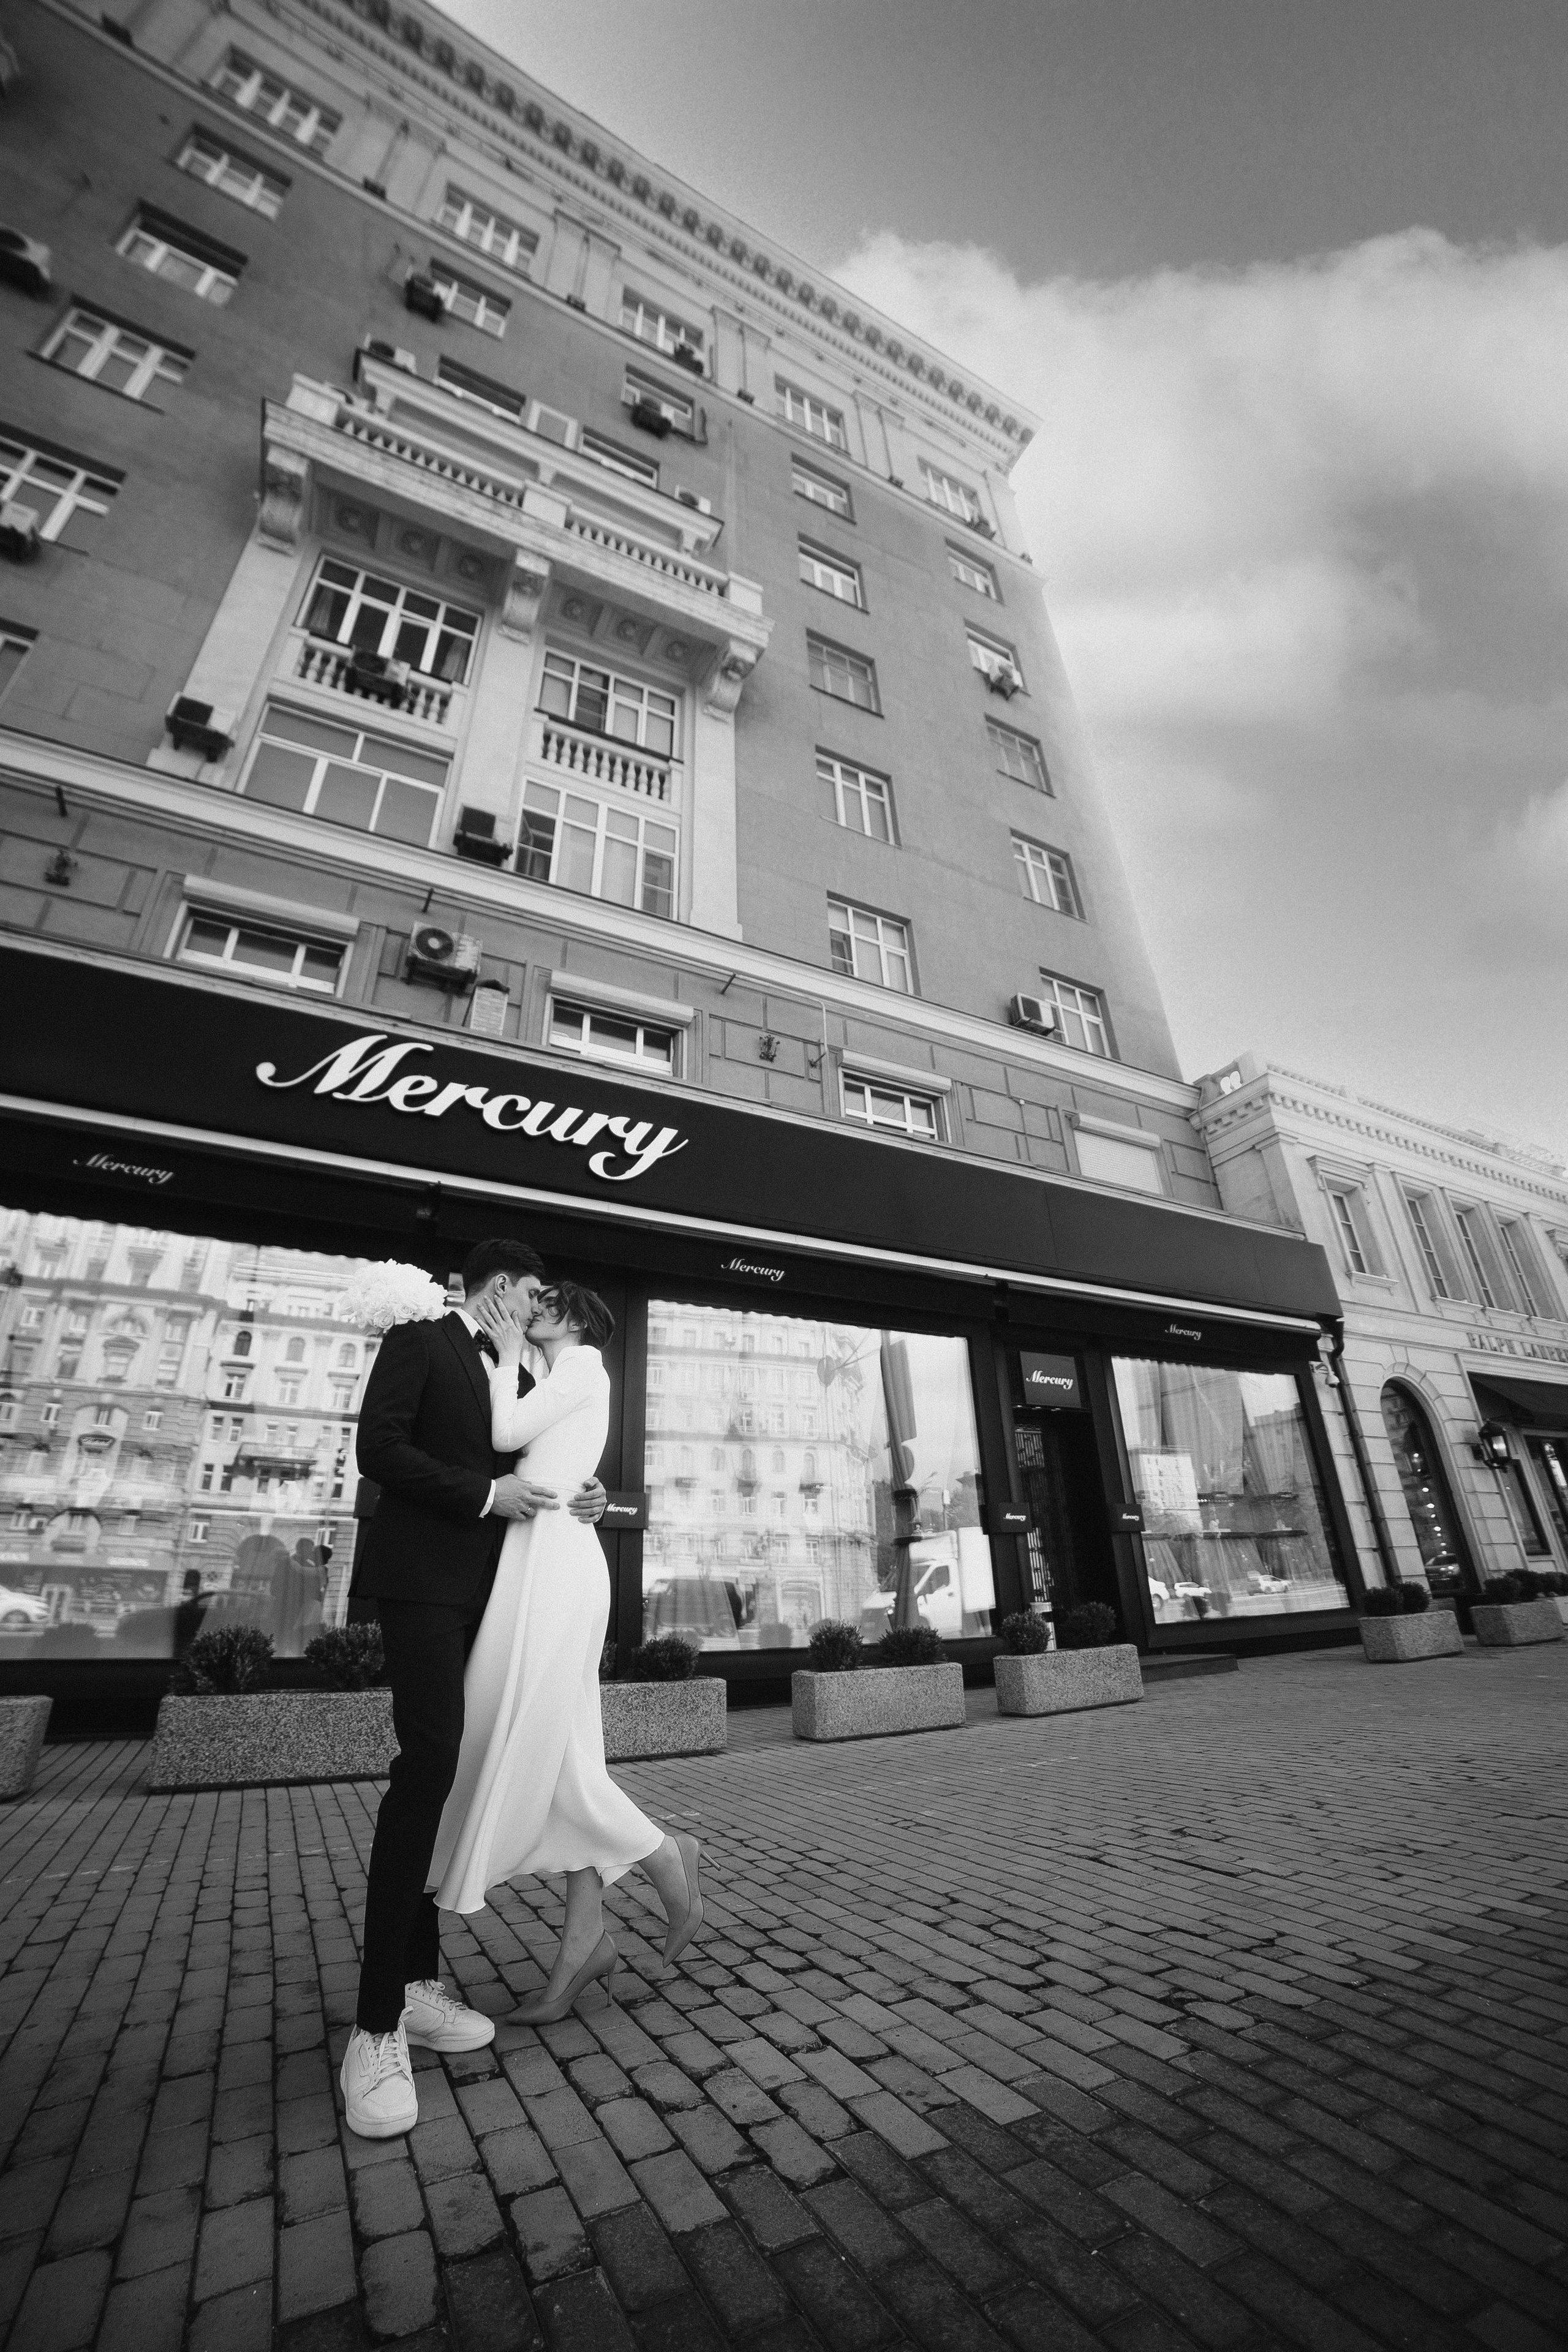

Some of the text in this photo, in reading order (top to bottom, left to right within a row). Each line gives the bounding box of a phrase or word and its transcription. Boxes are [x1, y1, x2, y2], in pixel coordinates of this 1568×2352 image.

[256, 1035, 688, 1180] Mercury
[73, 1152, 174, 1185] Mercury
[721, 1257, 785, 1282] Mercury
[1165, 1324, 1202, 1341] Mercury
[1466, 1332, 1517, 1354] RALPH
[1025, 1370, 1074, 1390] Mercury
[605, 1503, 638, 1516] Mercury
